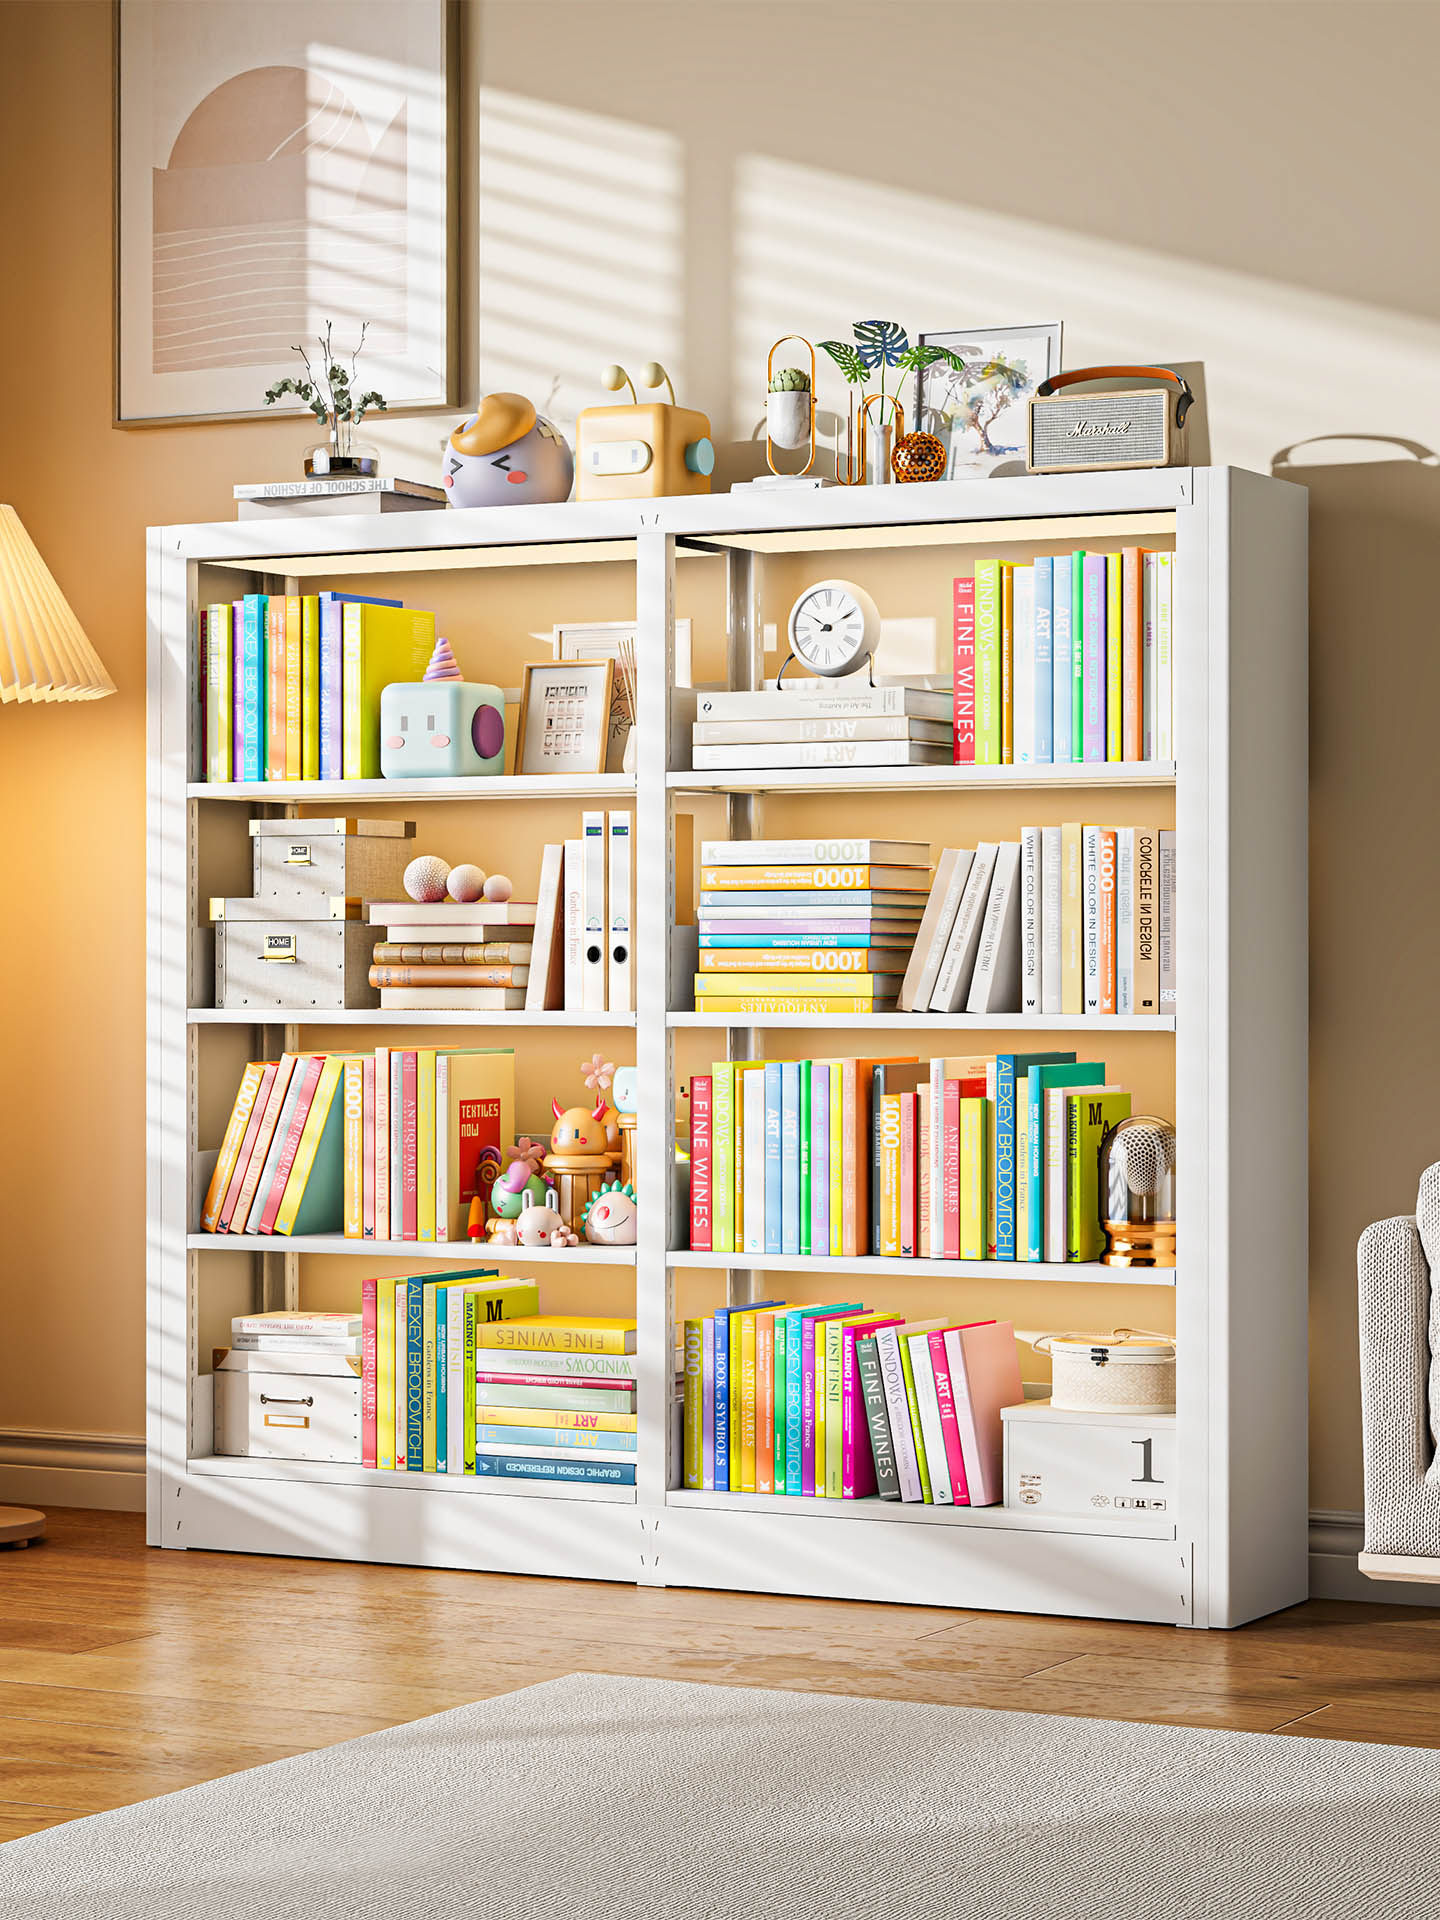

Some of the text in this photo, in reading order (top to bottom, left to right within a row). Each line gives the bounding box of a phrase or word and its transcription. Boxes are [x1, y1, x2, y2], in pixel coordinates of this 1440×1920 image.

[1066, 419, 1132, 438] Marshall
[264, 485, 307, 496] FASHION
[309, 484, 323, 494] OF
[325, 481, 367, 493] SCHOOL
[368, 479, 389, 491] THE
[980, 566, 994, 652] WINDOWS
[1037, 607, 1050, 639] ART
[1055, 606, 1070, 639] ART
[957, 603, 974, 656] FINE
[957, 666, 974, 744] WINES
[824, 721, 857, 738] ART
[813, 868, 864, 887] 1000
[1101, 838, 1114, 892] 1000
[1026, 835, 1035, 976] WHITE COLOR IN DESIGN
[1088, 835, 1096, 976] WHITE COLOR IN DESIGN
[269, 937, 290, 946] HOME
[811, 952, 862, 970] 1000
[980, 941, 994, 972] DREAM
[234, 1069, 260, 1122] 1000
[346, 1066, 362, 1120] 1000
[461, 1103, 499, 1120] TEXTILES
[715, 1069, 730, 1146] WINDOWS
[461, 1123, 479, 1138] NOW
[693, 1101, 708, 1149] FINE
[767, 1108, 779, 1138] ART
[883, 1101, 900, 1148] 1000
[1069, 1104, 1077, 1158] MAKING IT
[278, 1103, 308, 1191] ANTIQUAIRES
[407, 1098, 416, 1192] ANTIQUAIRES
[998, 1060, 1012, 1247] ALEXEY BRODOVITCH
[949, 1125, 958, 1213] ANTIQUAIRES
[693, 1156, 708, 1229] WINES
[219, 1219, 229, 1230] K
[364, 1226, 374, 1236] K
[902, 1245, 912, 1255] K
[1068, 1249, 1078, 1259] K
[466, 1350, 473, 1361] IT
[496, 1329, 604, 1350] FINE WINES
[685, 1327, 701, 1376] 1000
[367, 1328, 376, 1420] ANTIQUAIRES
[409, 1283, 421, 1458] ALEXEY BRODOVITCH
[426, 1379, 433, 1388] in
[566, 1357, 632, 1375] WINDOWS
[716, 1352, 726, 1388] BOOK
[828, 1327, 839, 1402] LOST FISH
[844, 1335, 852, 1392] MAKING IT
[862, 1361, 882, 1406] FINE
[880, 1332, 903, 1405] WINDOWS
[745, 1360, 754, 1448] ANTIQUAIRES
[788, 1318, 800, 1484] ALEXEY BRODOVITCH
[935, 1372, 951, 1399] ART
[573, 1414, 598, 1428] ART
[804, 1371, 812, 1448] Gardens in France
[573, 1433, 599, 1447] ART
[716, 1402, 726, 1466] SYMBOLS
[871, 1413, 894, 1479] WINES
[397, 1455, 406, 1465] K
[465, 1460, 474, 1470] K
[506, 1463, 621, 1478] GRAPHIC DESIGN REFERENCED
[1131, 1437, 1165, 1484] 1
